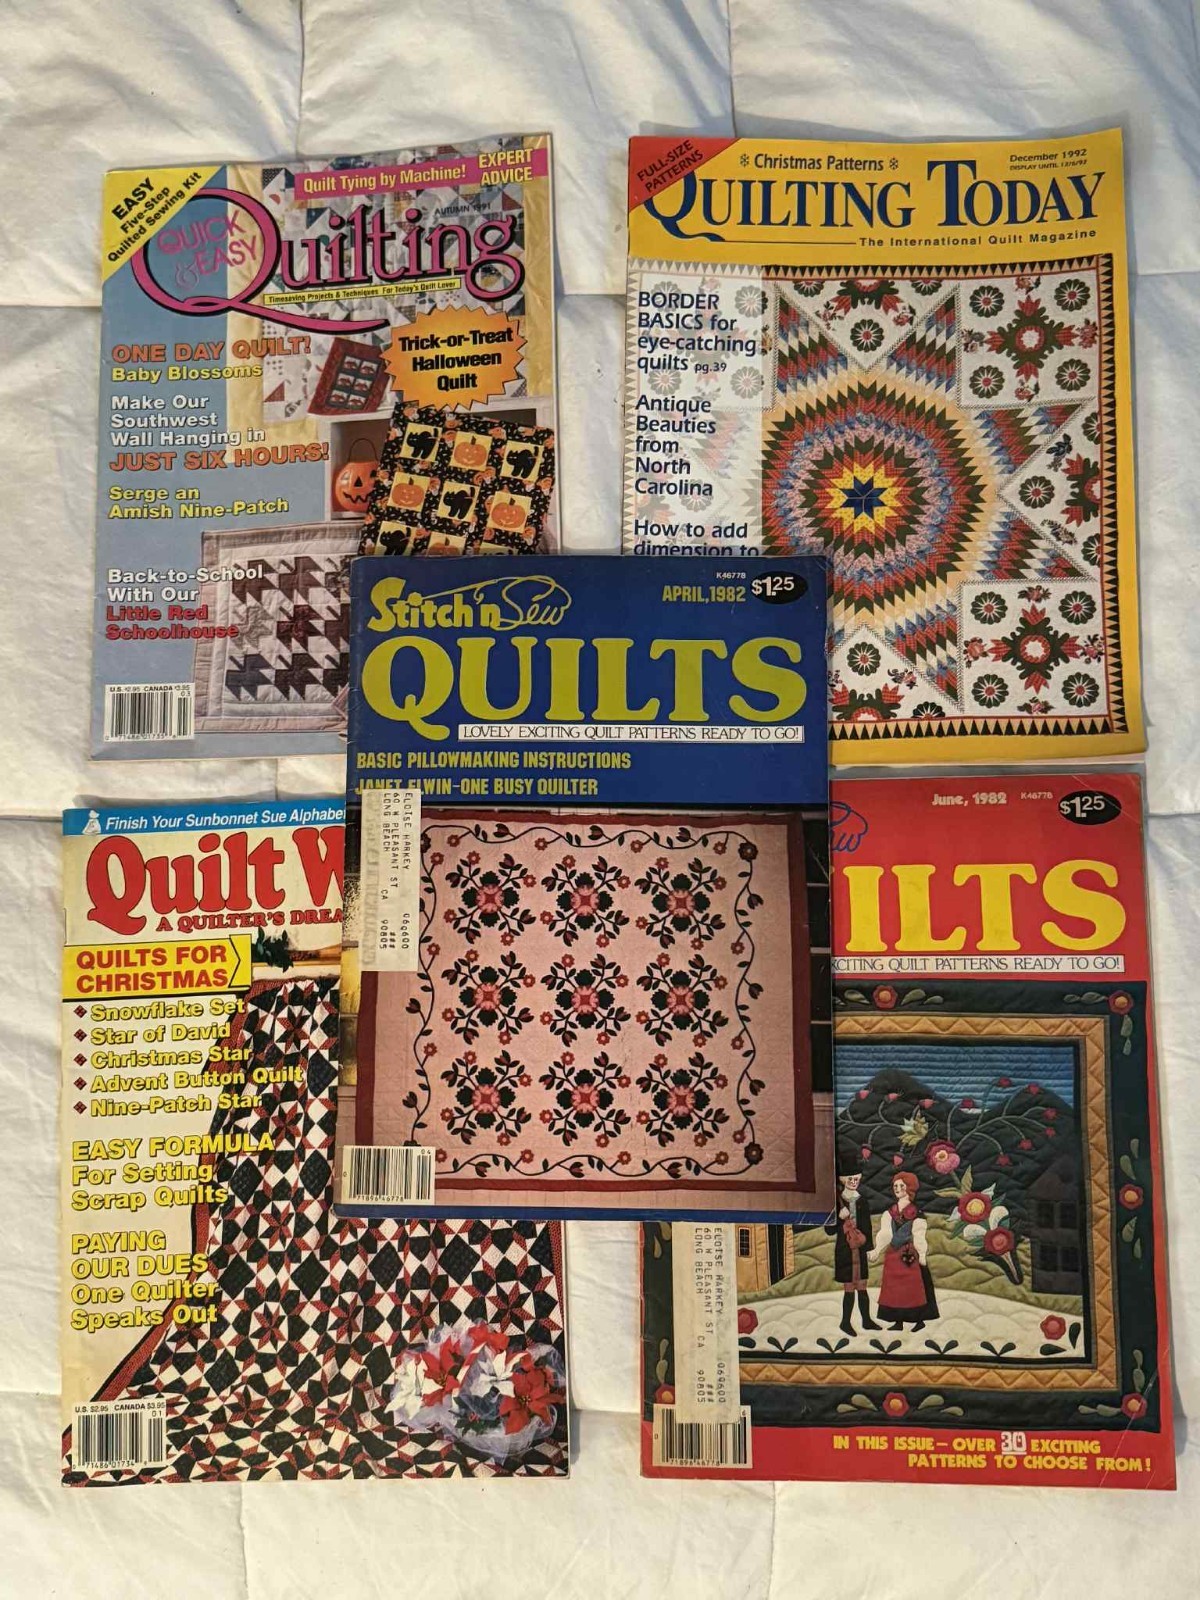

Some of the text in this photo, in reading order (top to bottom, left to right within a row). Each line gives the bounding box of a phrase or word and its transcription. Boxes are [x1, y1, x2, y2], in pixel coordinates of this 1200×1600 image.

[478, 148, 533, 169] EXPERT
[637, 140, 693, 181] FULL-SIZE
[754, 153, 884, 171] Christmas Patterns
[1010, 149, 1087, 162] December 1992
[304, 164, 466, 193] Quilt Tying by Machine!
[481, 167, 532, 186] ADVICE
[645, 150, 703, 192] PATTERNS
[111, 177, 154, 220] EASY
[643, 160, 1106, 242] QUILTING TODAY
[107, 172, 202, 262] Quilted Sewing Kit
[120, 187, 170, 234] Five-Step
[434, 205, 470, 216] AUTUMN
[157, 210, 246, 255] QUICK
[860, 229, 1097, 247] The International Quilt Magazine
[131, 188, 525, 334] Quilting
[196, 236, 258, 276] EASY
[269, 281, 456, 304] Timesaving Projects Techniques For Today's Quilt Lover
[638, 291, 720, 310] BORDER
[638, 312, 737, 331] BASICS for
[112, 336, 312, 363] ONE DAY QUILT!
[398, 327, 514, 351] Trick-or-Treat
[637, 335, 757, 357] eye-catching
[412, 352, 502, 372] Halloween
[637, 354, 689, 374] quilts
[111, 364, 263, 384] Baby Blossoms
[437, 373, 478, 391] Quilt
[111, 394, 209, 410] Make Our
[636, 395, 711, 415] Antique
[111, 412, 218, 429] Southwest
[636, 416, 716, 434] Beauties
[111, 427, 266, 447] Wall Hanging in
[636, 436, 679, 453] from
[109, 442, 329, 471] JUST SIX HOURS!
[635, 457, 691, 475] North
[108, 486, 200, 503] Serge an
[635, 478, 713, 496] Carolina
[108, 499, 289, 519] Amish Nine-Patch
[634, 520, 748, 539] How to add
[634, 541, 759, 556] dimension to
[108, 564, 263, 584] Back-to-School
[108, 587, 200, 602] With Our
[501, 575, 572, 632] Sew
[106, 604, 208, 622] Little Red
[105, 623, 240, 640] Schoolhouse
[362, 635, 807, 741] QUILTS
[464, 726, 799, 740] LOVELY EXCITING QUILT PATTERNS READY TO GO!
[356, 751, 631, 769] BASIC PILLOWMAKING INSTRUCTIONS
[354, 778, 402, 794] JANET
[493, 778, 533, 795] BUSY
[537, 778, 598, 795] QUILTER
[932, 791, 1007, 807] June, 1982
[105, 810, 287, 830] Finish Your Sunbonnet Sue
[86, 831, 286, 936] Quilt
[831, 859, 1126, 952] ILTS
[156, 911, 285, 934] A QUILTER'S
[76, 946, 226, 970] QUILTS FOR
[888, 957, 1120, 972] QUILT PATTERNS READY TO GO!
[76, 969, 228, 993] CHRISTMAS
[91, 998, 246, 1022] Snowflake Set
[91, 1022, 231, 1046] Star of David
[91, 1046, 253, 1070] Christmas Star
[90, 1066, 304, 1093] Advent Button Quilt
[90, 1093, 263, 1117] Nine-Patch Star
[72, 1132, 275, 1161] EASY FORMULA
[72, 1161, 214, 1186] For Setting
[72, 1185, 229, 1212] Scrap Quilts
[72, 1230, 166, 1254] PAYING
[72, 1253, 209, 1279] OUR DUES
[71, 1279, 218, 1305] One Quilter
[71, 1304, 218, 1333] Speaks Out
[833, 1431, 1101, 1454] IN THIS 30 EXCITING
[908, 1454, 987, 1468] PATTERNS
[994, 1455, 1017, 1470] TO
[1023, 1456, 1088, 1470] CHOOSE
